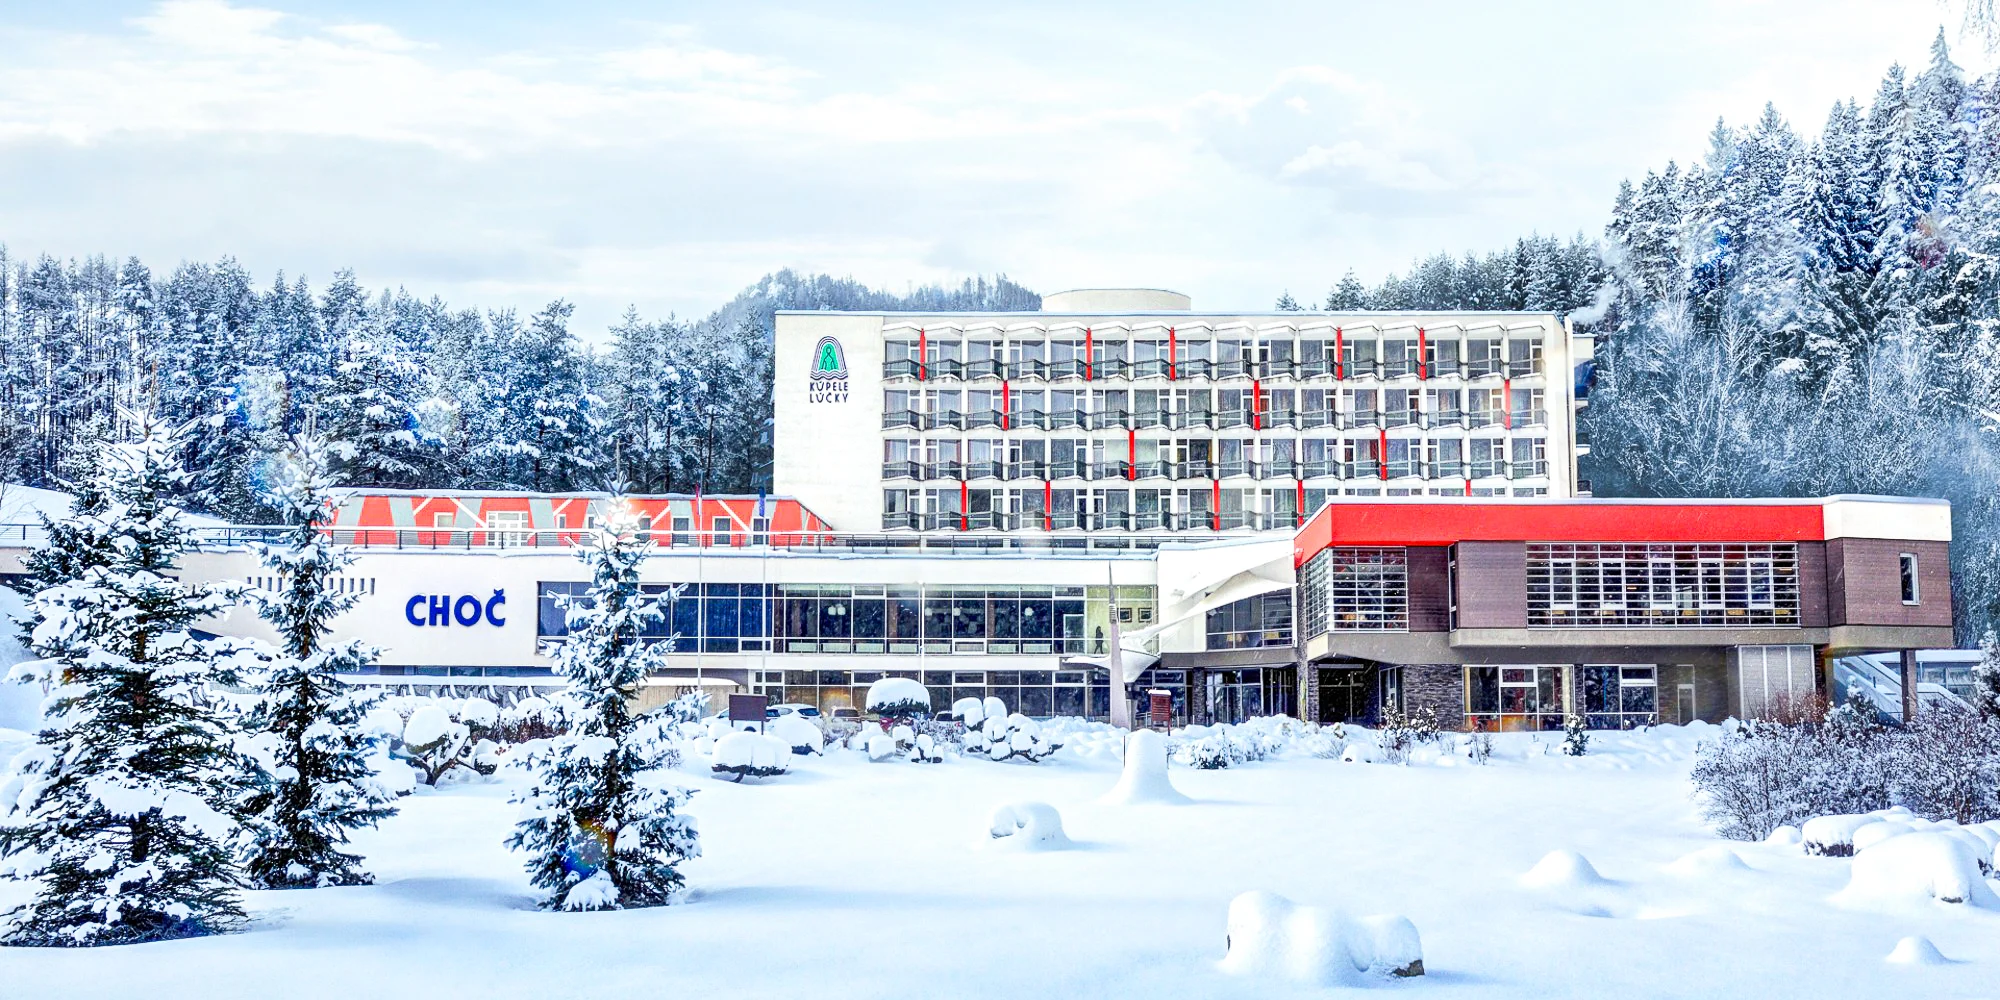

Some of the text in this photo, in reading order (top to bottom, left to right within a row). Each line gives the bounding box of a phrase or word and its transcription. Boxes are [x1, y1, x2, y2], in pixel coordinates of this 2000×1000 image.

[809, 381, 848, 392] KÚPELE
[809, 392, 849, 403] LÚČKY
[405, 588, 506, 627] CHOČ
